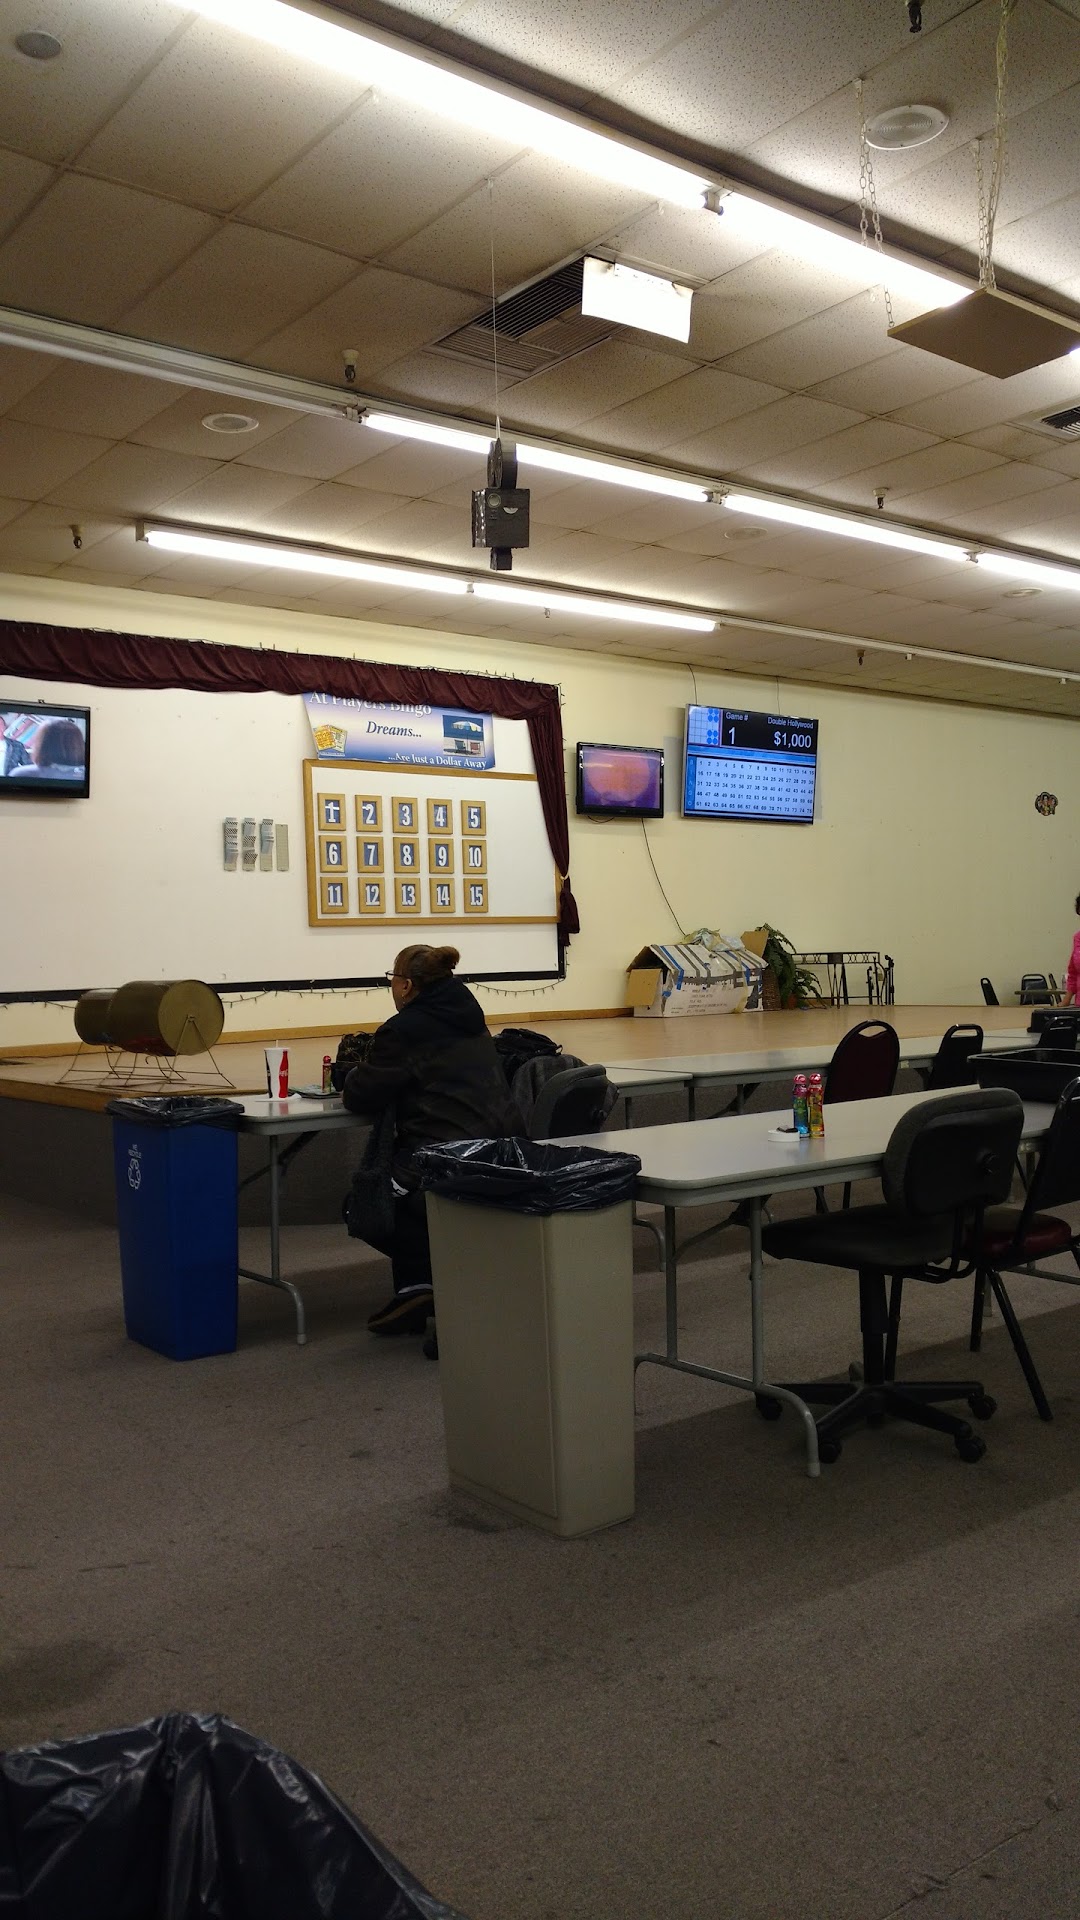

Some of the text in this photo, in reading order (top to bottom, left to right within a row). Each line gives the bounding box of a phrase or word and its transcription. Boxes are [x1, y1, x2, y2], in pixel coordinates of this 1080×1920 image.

[309, 691, 328, 705] At
[725, 711, 743, 721] Game
[767, 716, 814, 729] Double Hollywood
[366, 721, 422, 738] Dreams...
[728, 727, 736, 745] 1
[774, 731, 812, 749] $1,000
[388, 752, 487, 770] ...Are Just a Dollar Away
[327, 801, 479, 828] 1 2 3 4 5
[329, 843, 482, 867] 6 7 8 9 10
[328, 885, 483, 906] 11 12 13 14 15
